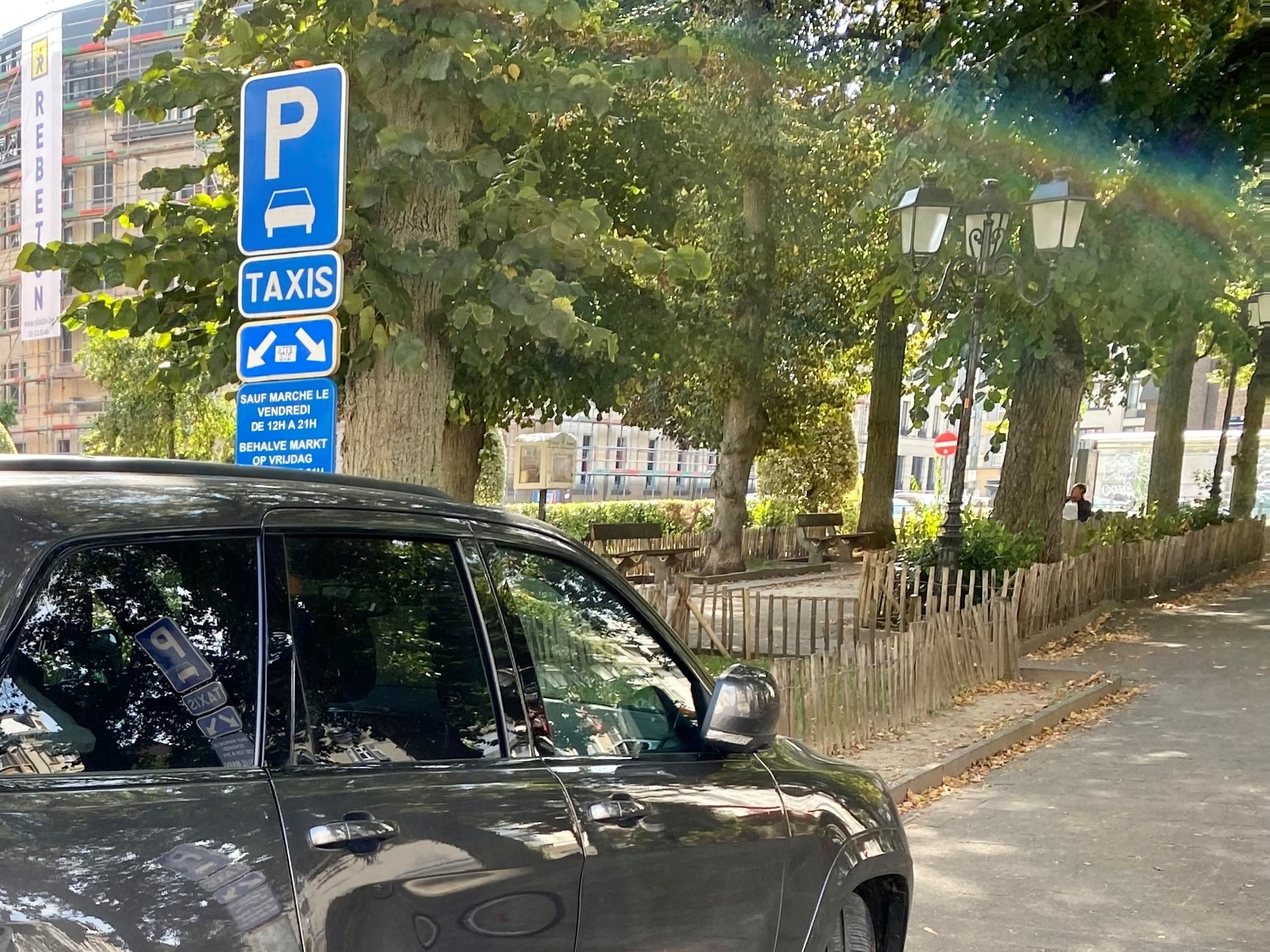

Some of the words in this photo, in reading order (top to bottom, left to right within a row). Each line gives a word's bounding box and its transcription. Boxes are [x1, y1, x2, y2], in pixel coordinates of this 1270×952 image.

[265, 86, 318, 180] P
[246, 265, 333, 303] TAXIS
[240, 393, 267, 404] SAUF
[269, 390, 313, 403] MARCHE
[316, 389, 330, 399] LE
[257, 404, 311, 417] VENDREDI
[251, 421, 264, 432] DE
[267, 420, 286, 431] 12H
[288, 421, 296, 430] A
[297, 419, 317, 430] 21H
[239, 441, 287, 452] BEHALVE
[289, 438, 328, 450] MARKT
[252, 455, 266, 466] OP
[269, 454, 313, 465] VRIJDAG
